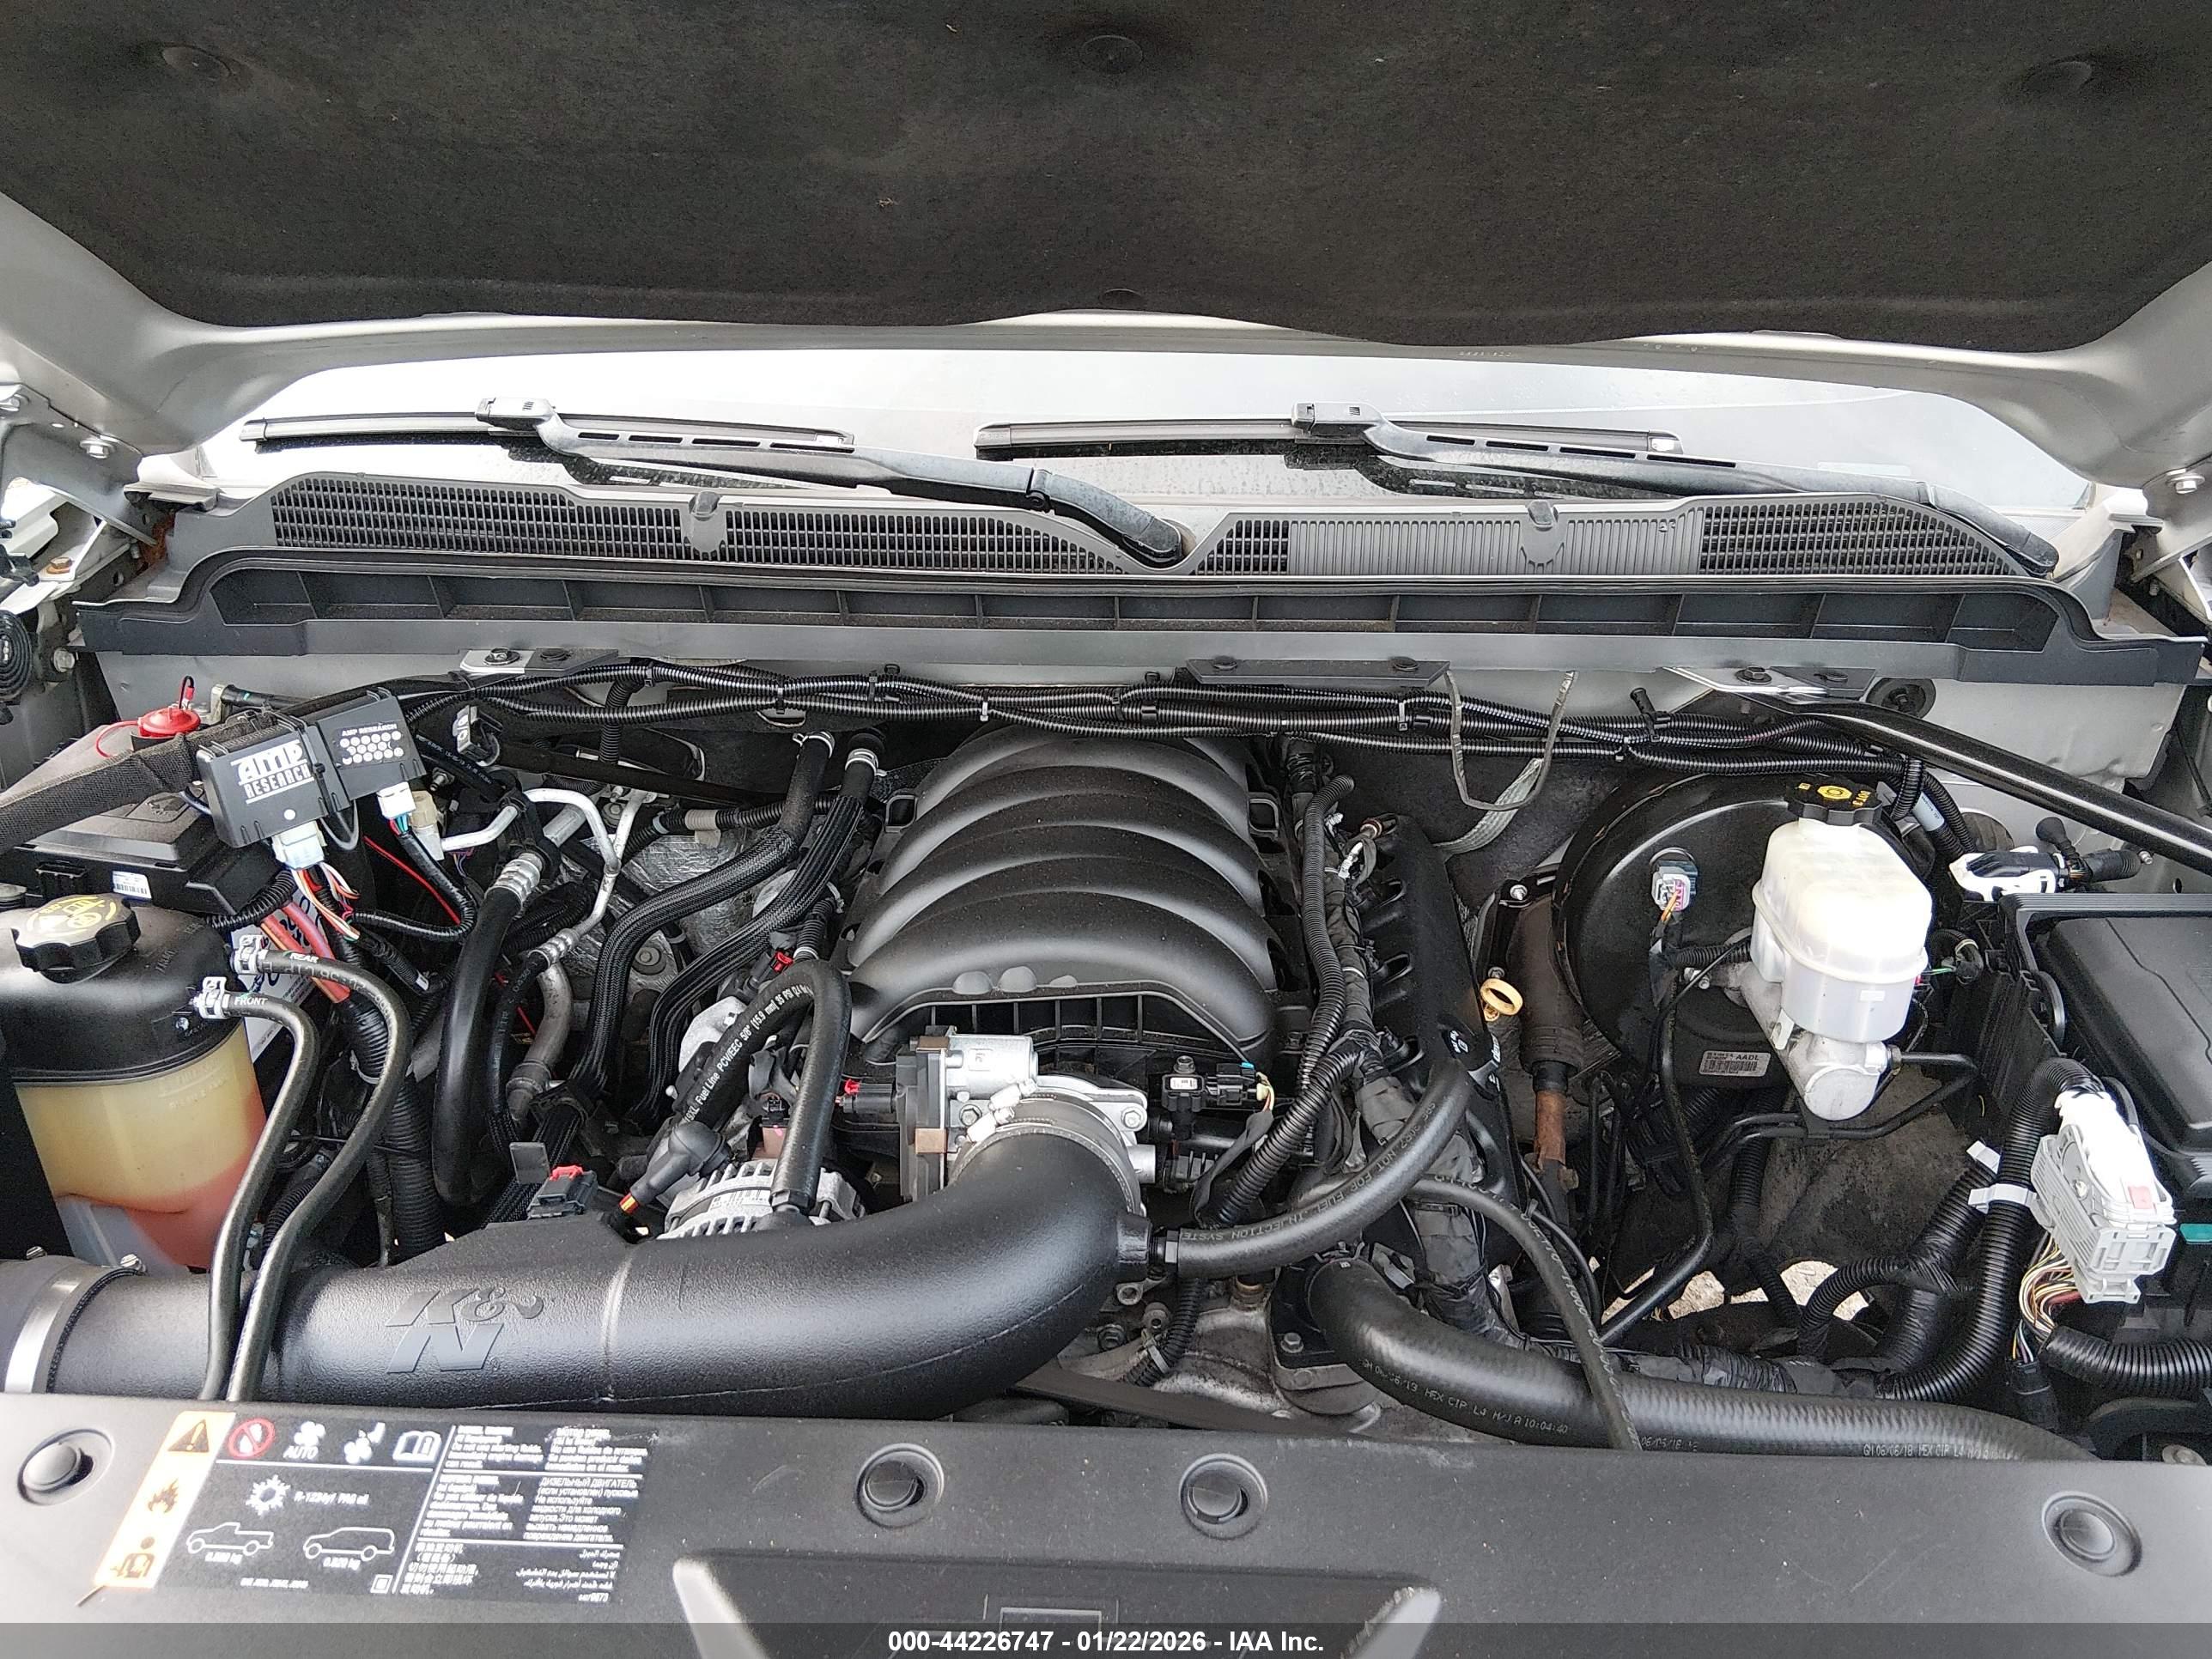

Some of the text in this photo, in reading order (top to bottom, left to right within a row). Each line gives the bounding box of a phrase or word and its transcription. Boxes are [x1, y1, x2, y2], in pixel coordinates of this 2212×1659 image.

[341, 723, 398, 736] AMP RESEARCH
[231, 739, 308, 785] AMP
[244, 763, 313, 800] RESEARCH
[289, 952, 319, 963] REAR
[234, 996, 268, 1006] FRONT
[696, 1084, 709, 1105] Fuel
[706, 1073, 720, 1090] Line
[717, 1039, 743, 1072] PCV/EEC
[1376, 1150, 1397, 1172] NOT
[1319, 1191, 1346, 1211] FUEL
[283, 1446, 319, 1460] AUTO
